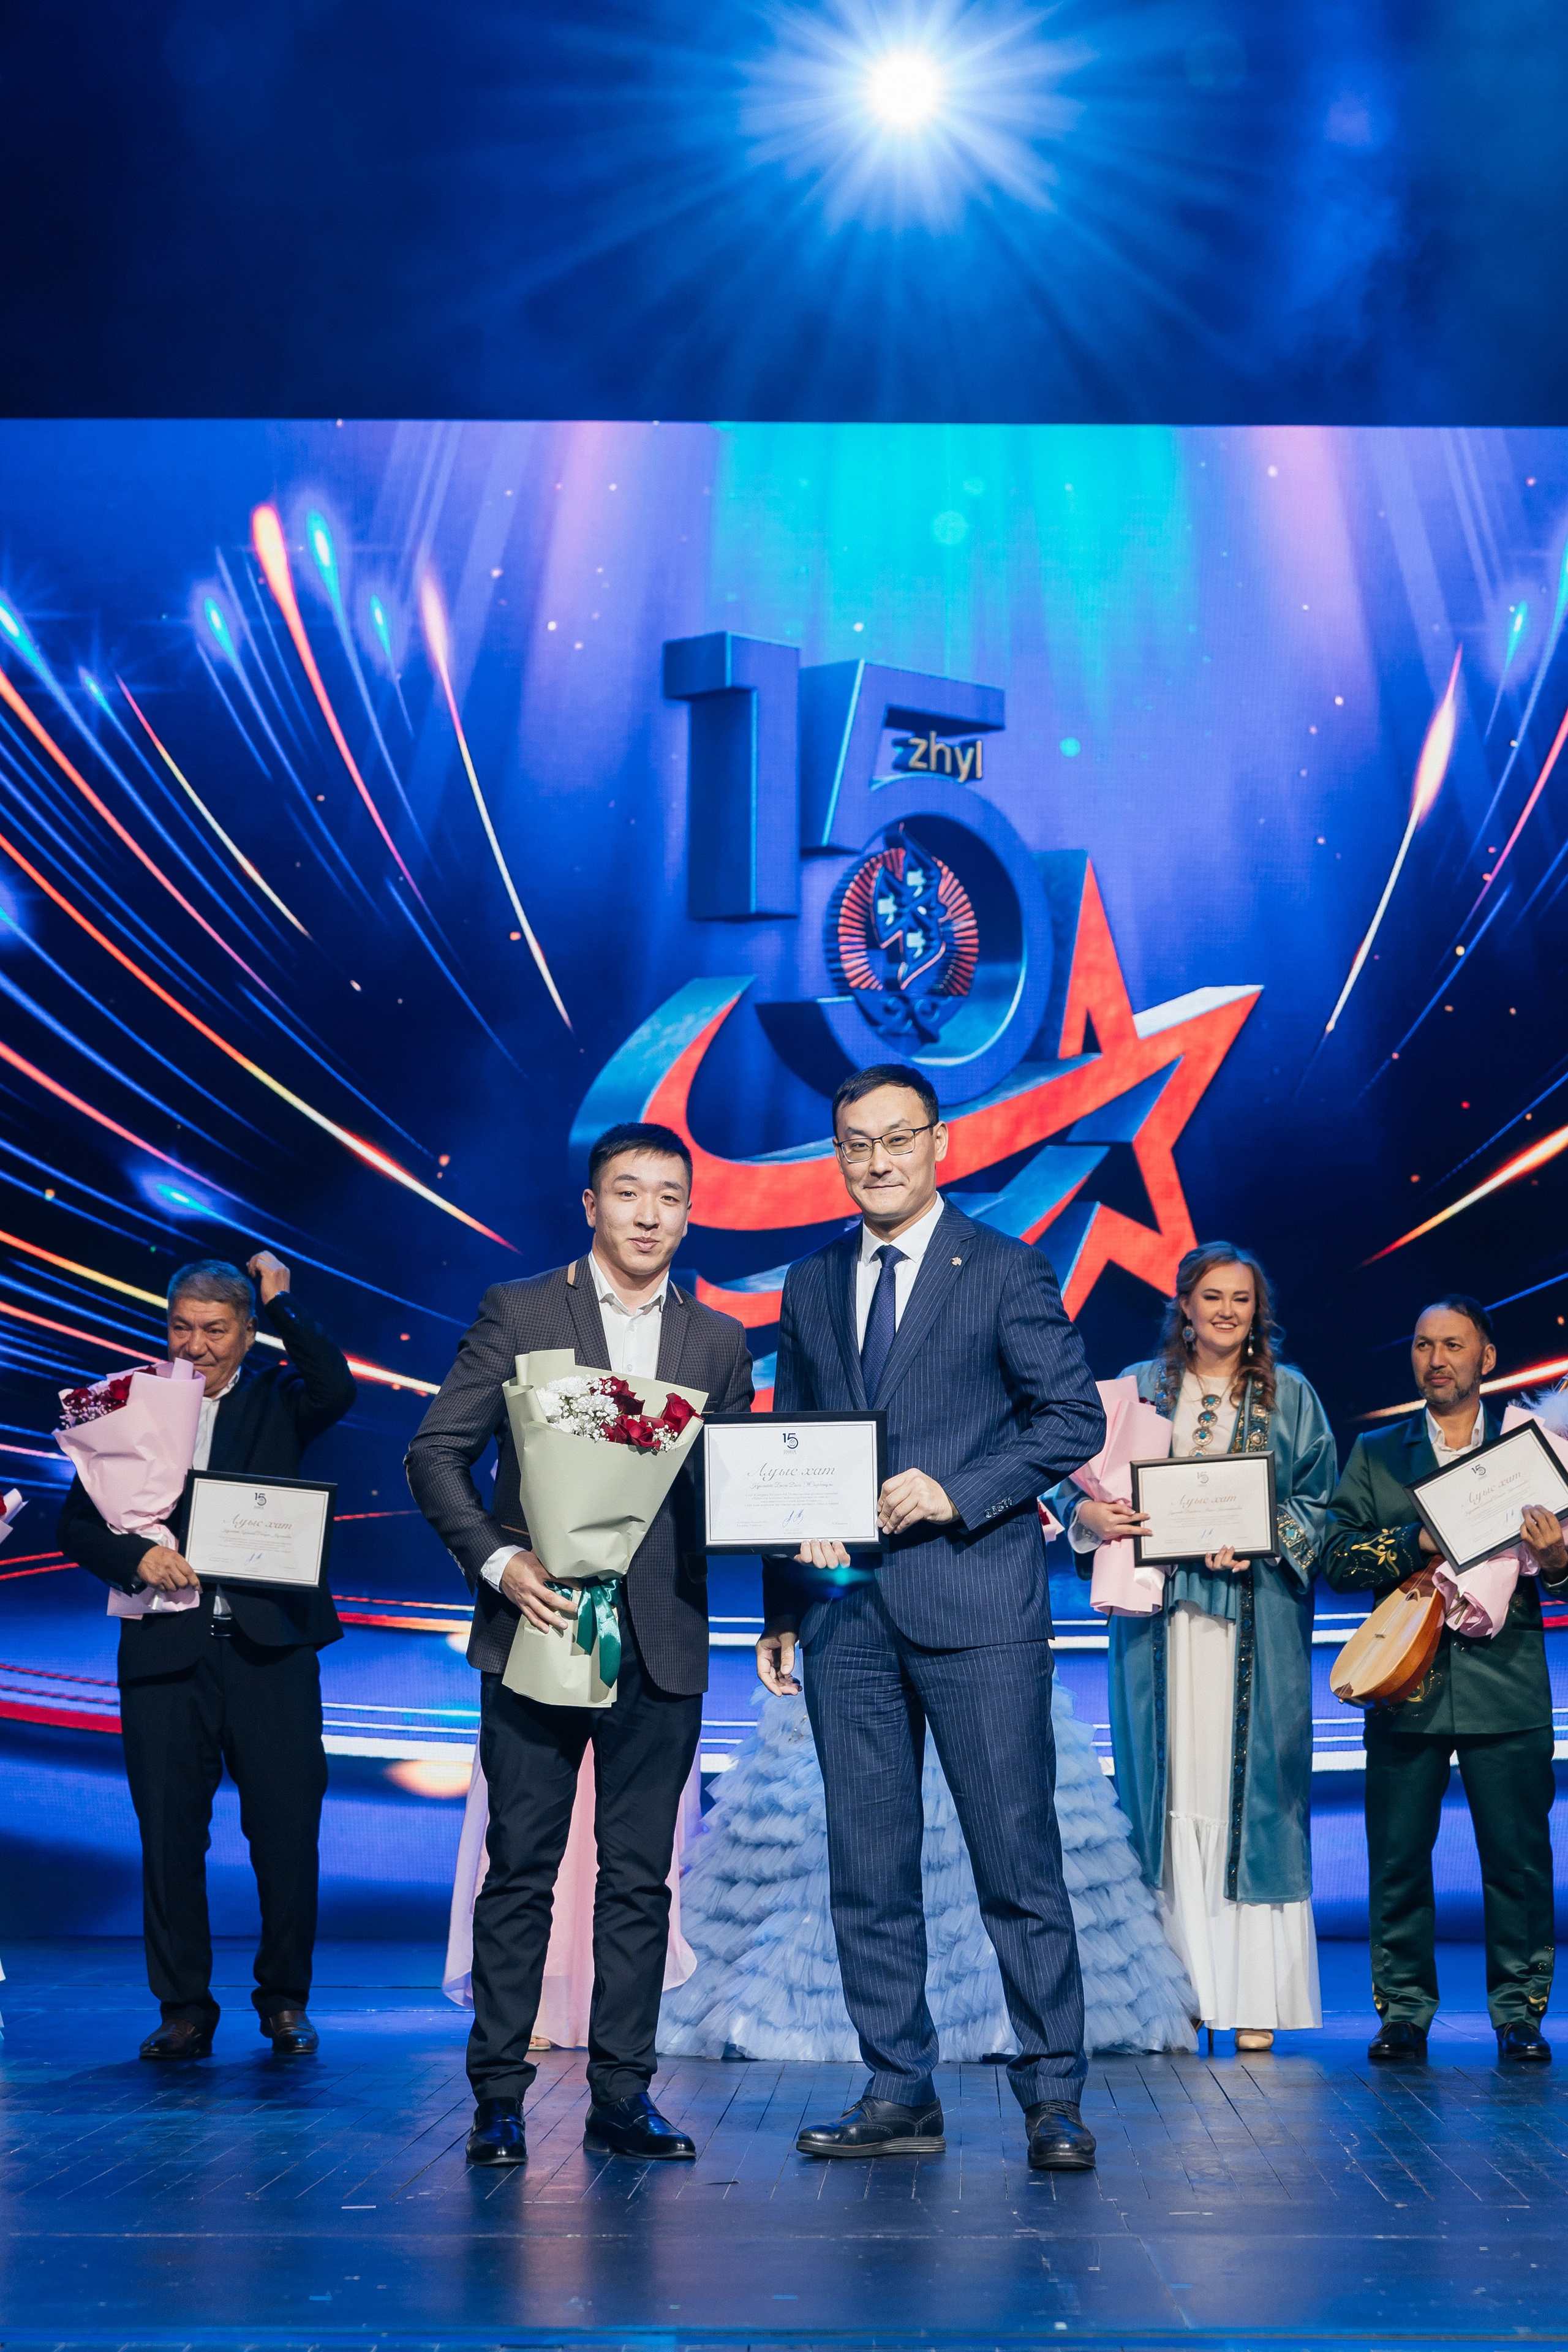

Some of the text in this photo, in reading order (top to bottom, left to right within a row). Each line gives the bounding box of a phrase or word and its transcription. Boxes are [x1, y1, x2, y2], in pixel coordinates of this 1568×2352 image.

[907, 731, 984, 784] zhyl
[663, 630, 1053, 1106] 15
[782, 1433, 799, 1449] 15
[1471, 1464, 1487, 1476] 15
[1197, 1472, 1209, 1483] 15
[255, 1493, 266, 1506] 15
